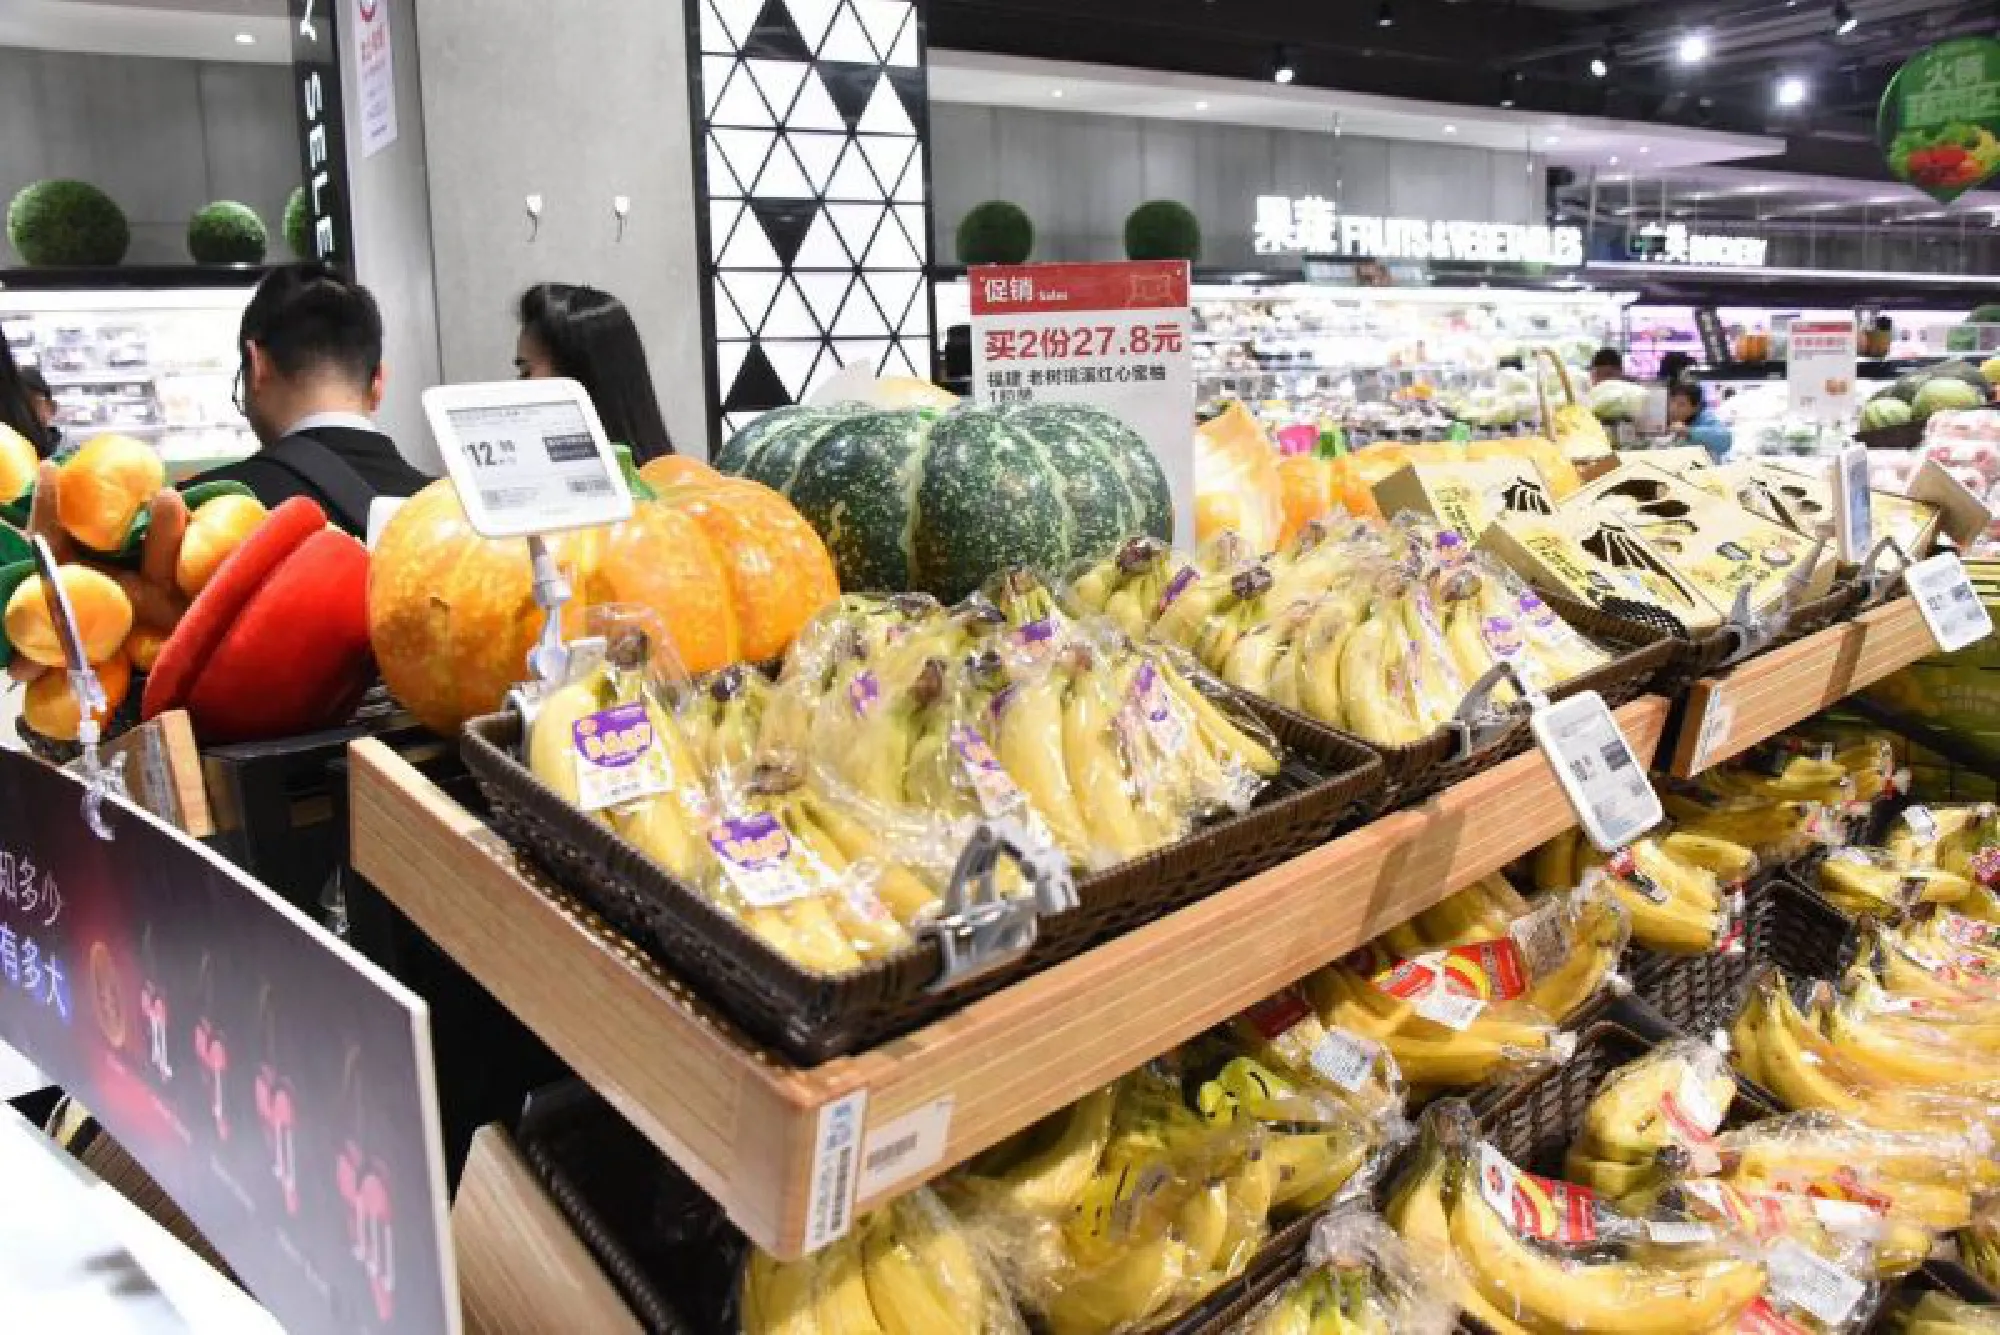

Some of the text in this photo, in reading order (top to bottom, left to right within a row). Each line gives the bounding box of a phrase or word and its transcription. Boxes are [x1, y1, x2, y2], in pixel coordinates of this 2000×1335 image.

[304, 71, 335, 269] SELE
[985, 275, 1033, 302] 促销
[985, 322, 1182, 361] 买2份27.8元
